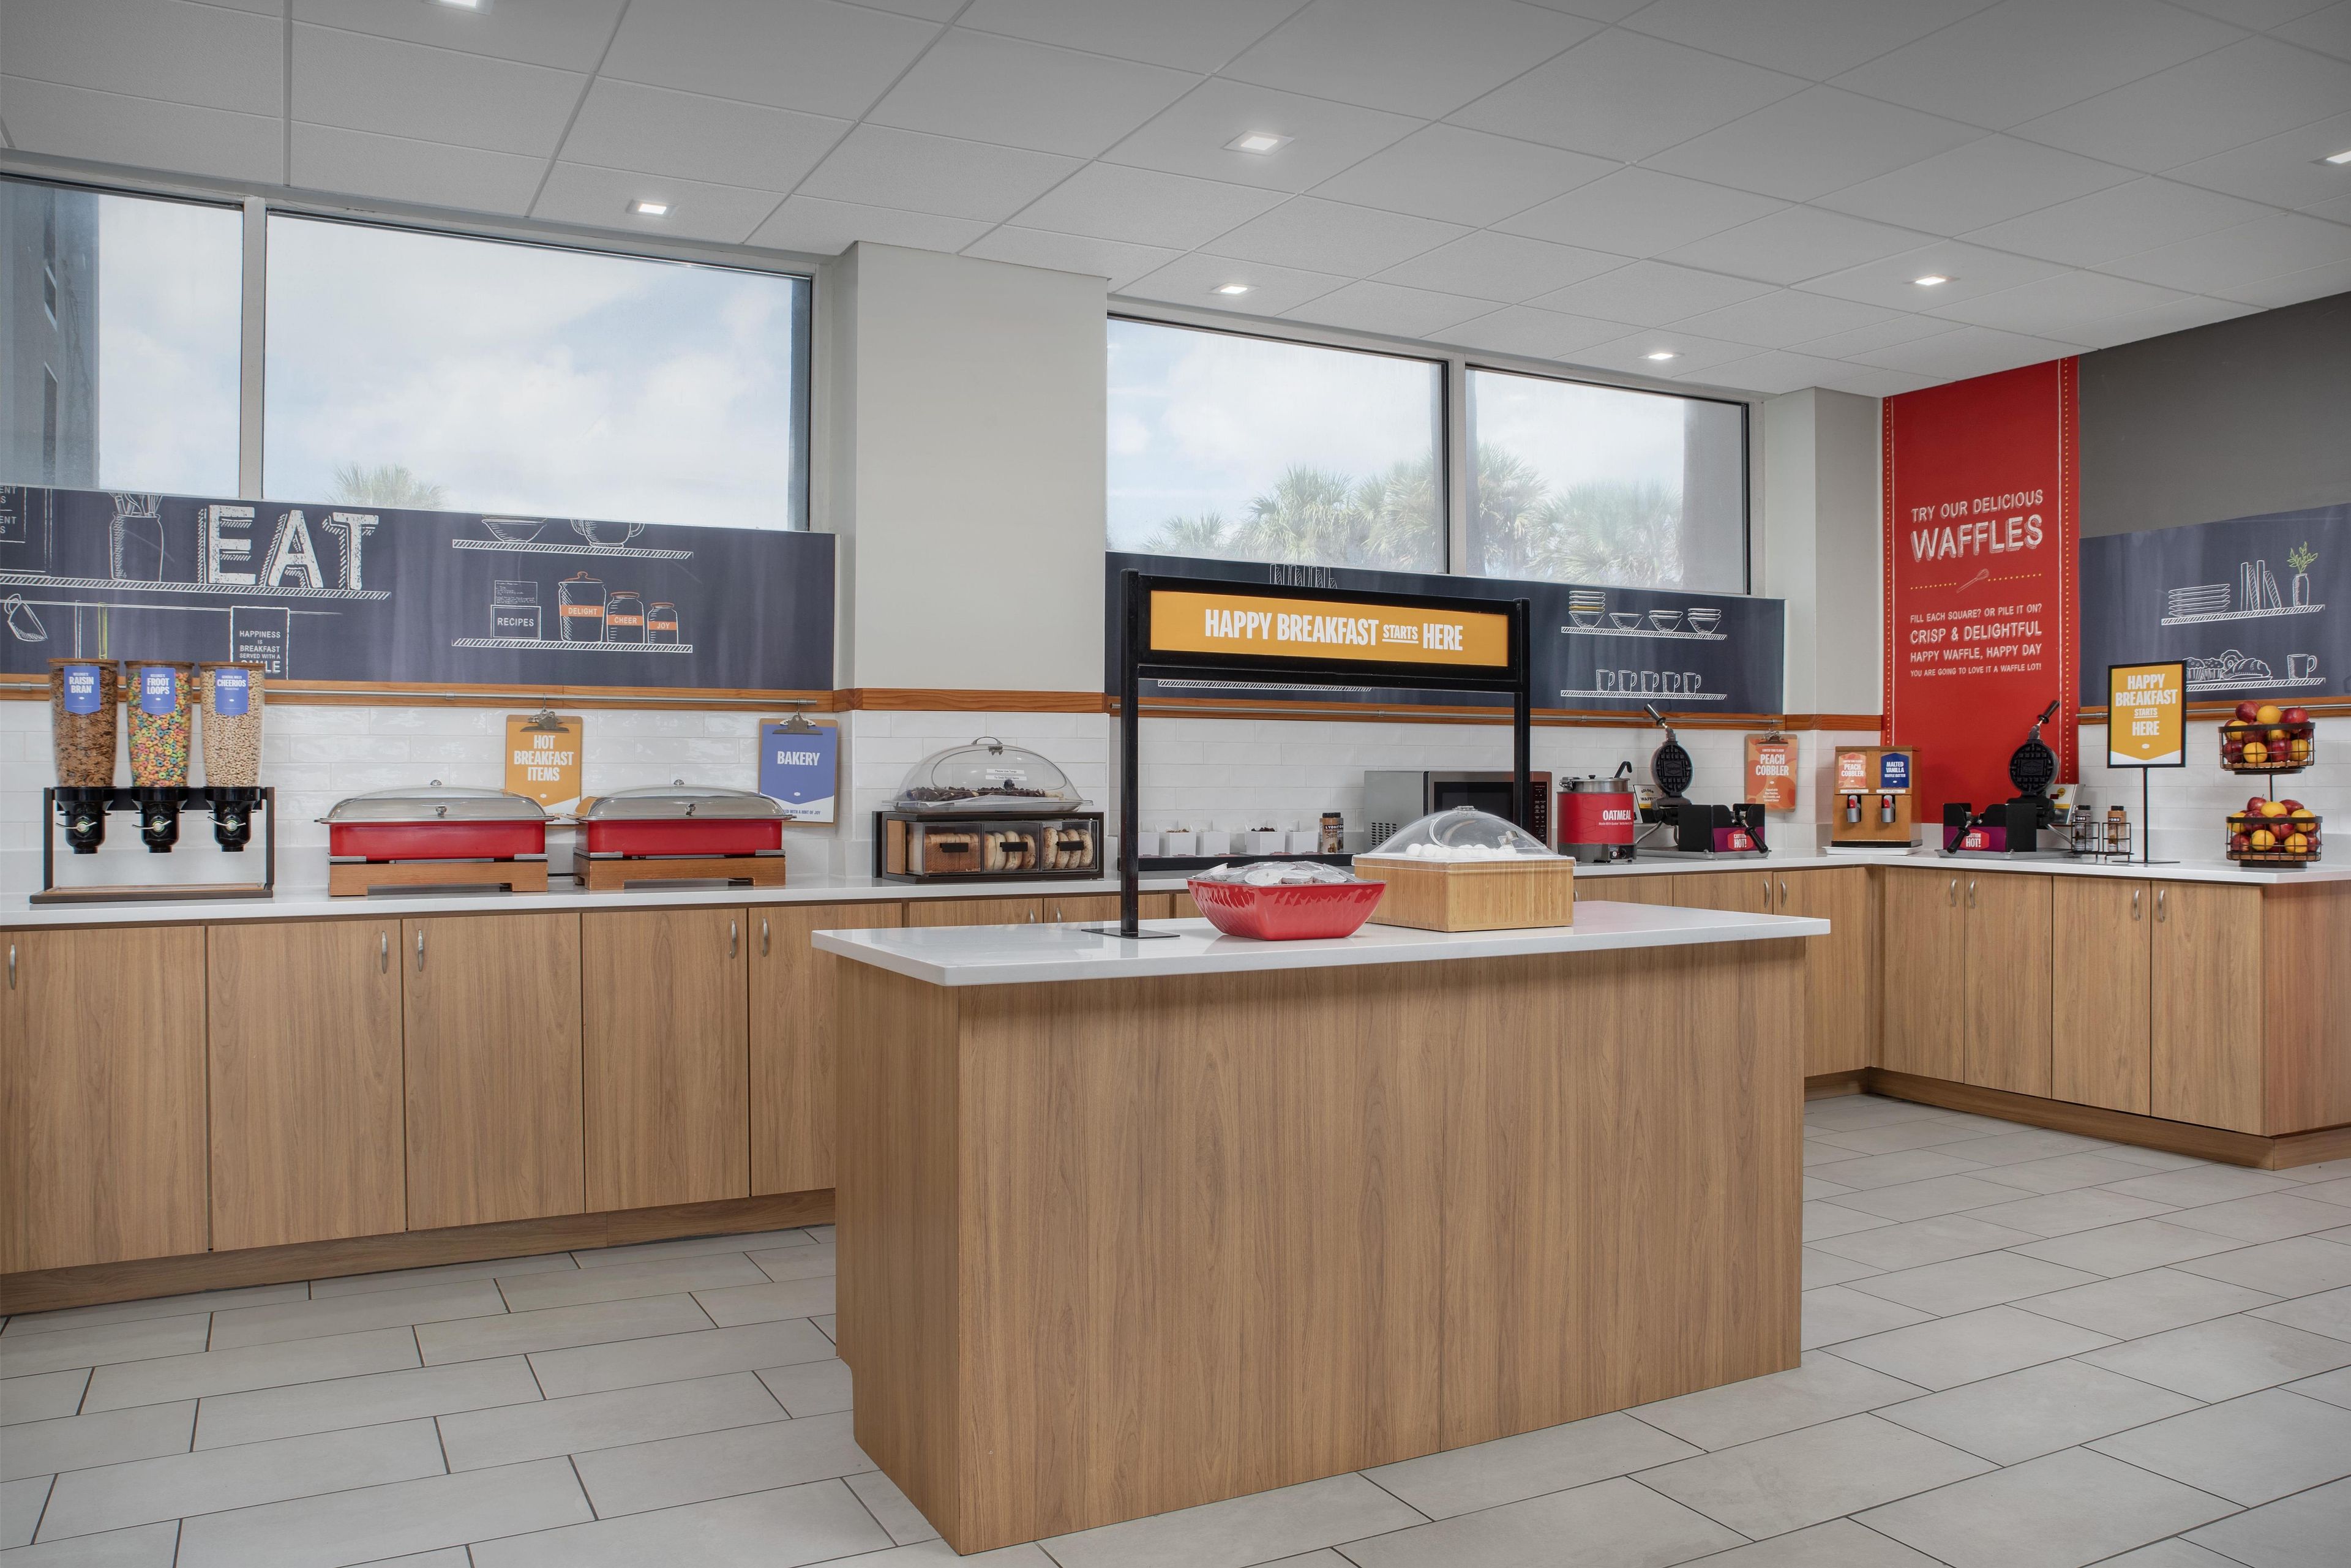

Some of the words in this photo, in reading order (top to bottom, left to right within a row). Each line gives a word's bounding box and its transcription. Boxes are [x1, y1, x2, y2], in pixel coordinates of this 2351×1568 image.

[1911, 505, 1935, 523] TRY
[1940, 501, 1968, 519] OUR
[1973, 489, 2043, 515] DELICIOUS
[1910, 514, 2043, 563] WAFFLES
[197, 505, 380, 590] EAT
[1910, 614, 1924, 623] FILL
[1926, 612, 1945, 622] EACH
[1948, 609, 1981, 620] SQUARE?
[1984, 608, 1995, 617] OR
[1998, 606, 2014, 616] PILE
[2016, 605, 2023, 615] IT
[2026, 603, 2042, 613] ON?
[497, 617, 534, 626] RECIPES
[1205, 609, 1272, 639] HAPPY
[1277, 613, 1379, 645] BREAKFAST
[1382, 625, 1418, 640] STARTS
[1423, 623, 1463, 651] HERE
[1910, 628, 1946, 645] CRISP
[1951, 627, 1959, 642] &
[1963, 620, 2042, 642] DELIGHTFUL
[1910, 650, 1939, 663] HAPPY
[1943, 647, 1984, 661] WAFFLE,
[1986, 645, 2019, 658] HAPPY
[2022, 643, 2042, 656] DAY
[1968, 666, 1984, 674] LOVE
[2000, 664, 2025, 672] WAFFLE
[69, 677, 94, 685] RAISIN
[2127, 673, 2165, 690] HAPPY
[2115, 689, 2178, 707] BREAKFAST
[2134, 708, 2158, 716] STARTS
[2132, 721, 2160, 736] HERE
[533, 735, 555, 749] HOT
[514, 751, 574, 765] BREAKFAST
[777, 751, 820, 766] BAKERY
[1760, 754, 1785, 764] PEACH
[528, 767, 560, 781] ITEMS
[1755, 765, 1789, 776] COBBLER
[1602, 810, 1632, 820] OATMEAL
[1734, 839, 1747, 848] HOT!
[1966, 838, 1981, 847] HOT!
